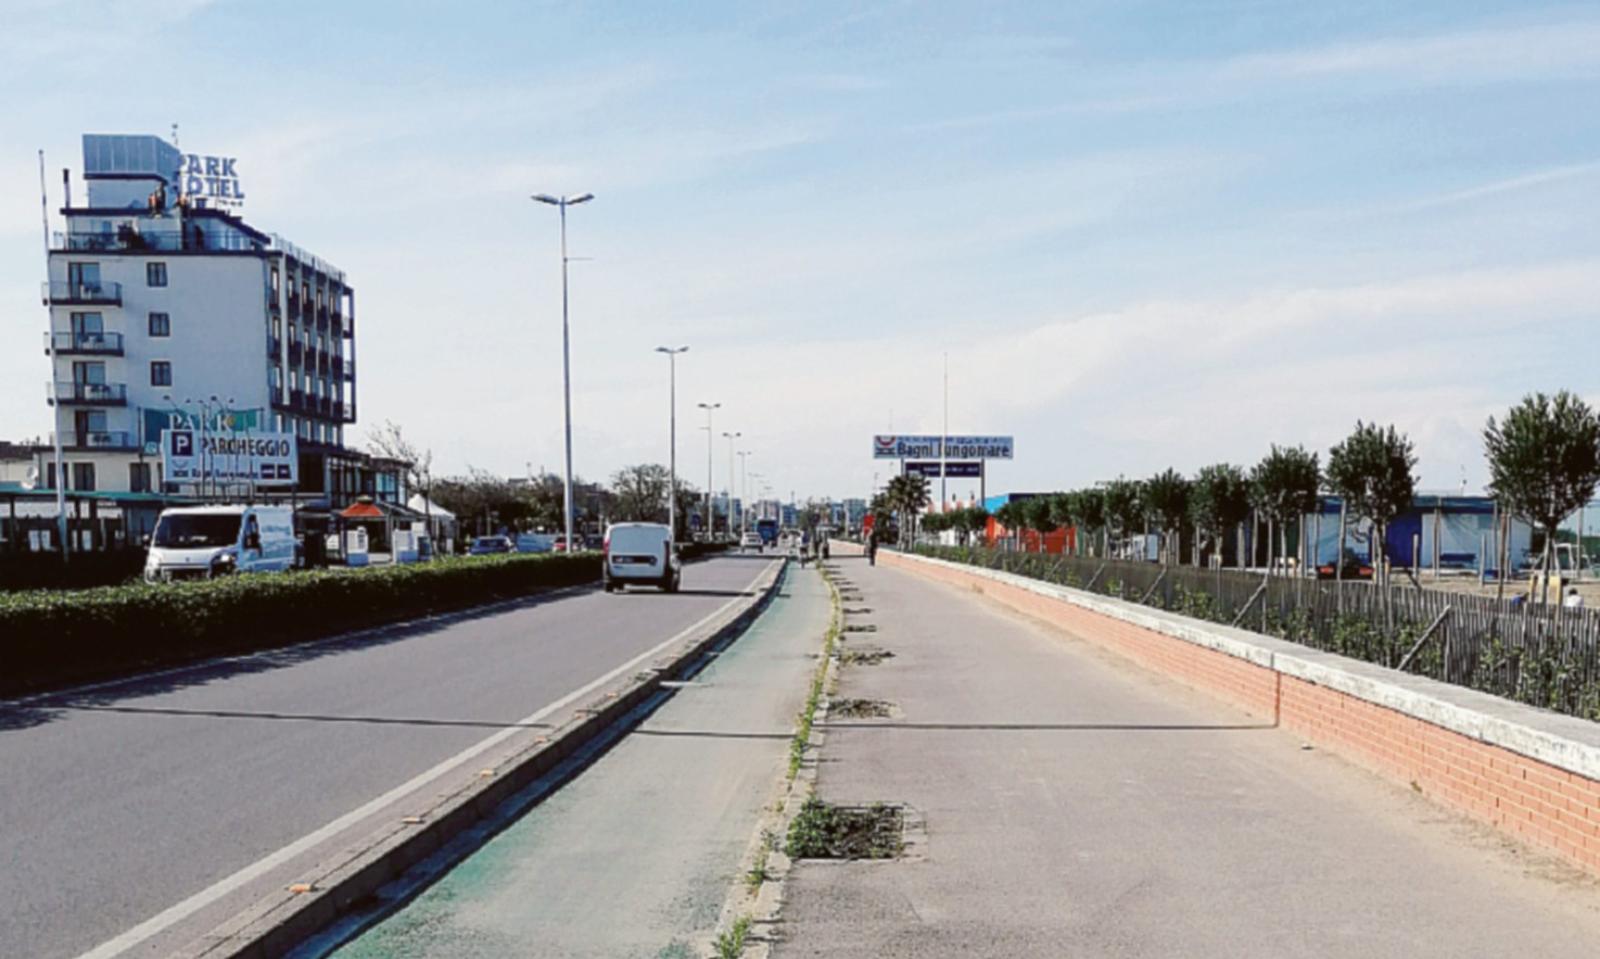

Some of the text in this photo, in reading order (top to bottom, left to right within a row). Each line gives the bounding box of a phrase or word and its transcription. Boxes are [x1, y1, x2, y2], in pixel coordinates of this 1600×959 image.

[177, 435, 290, 456] P PARCHEGGIO
[898, 442, 933, 458] Bagni
